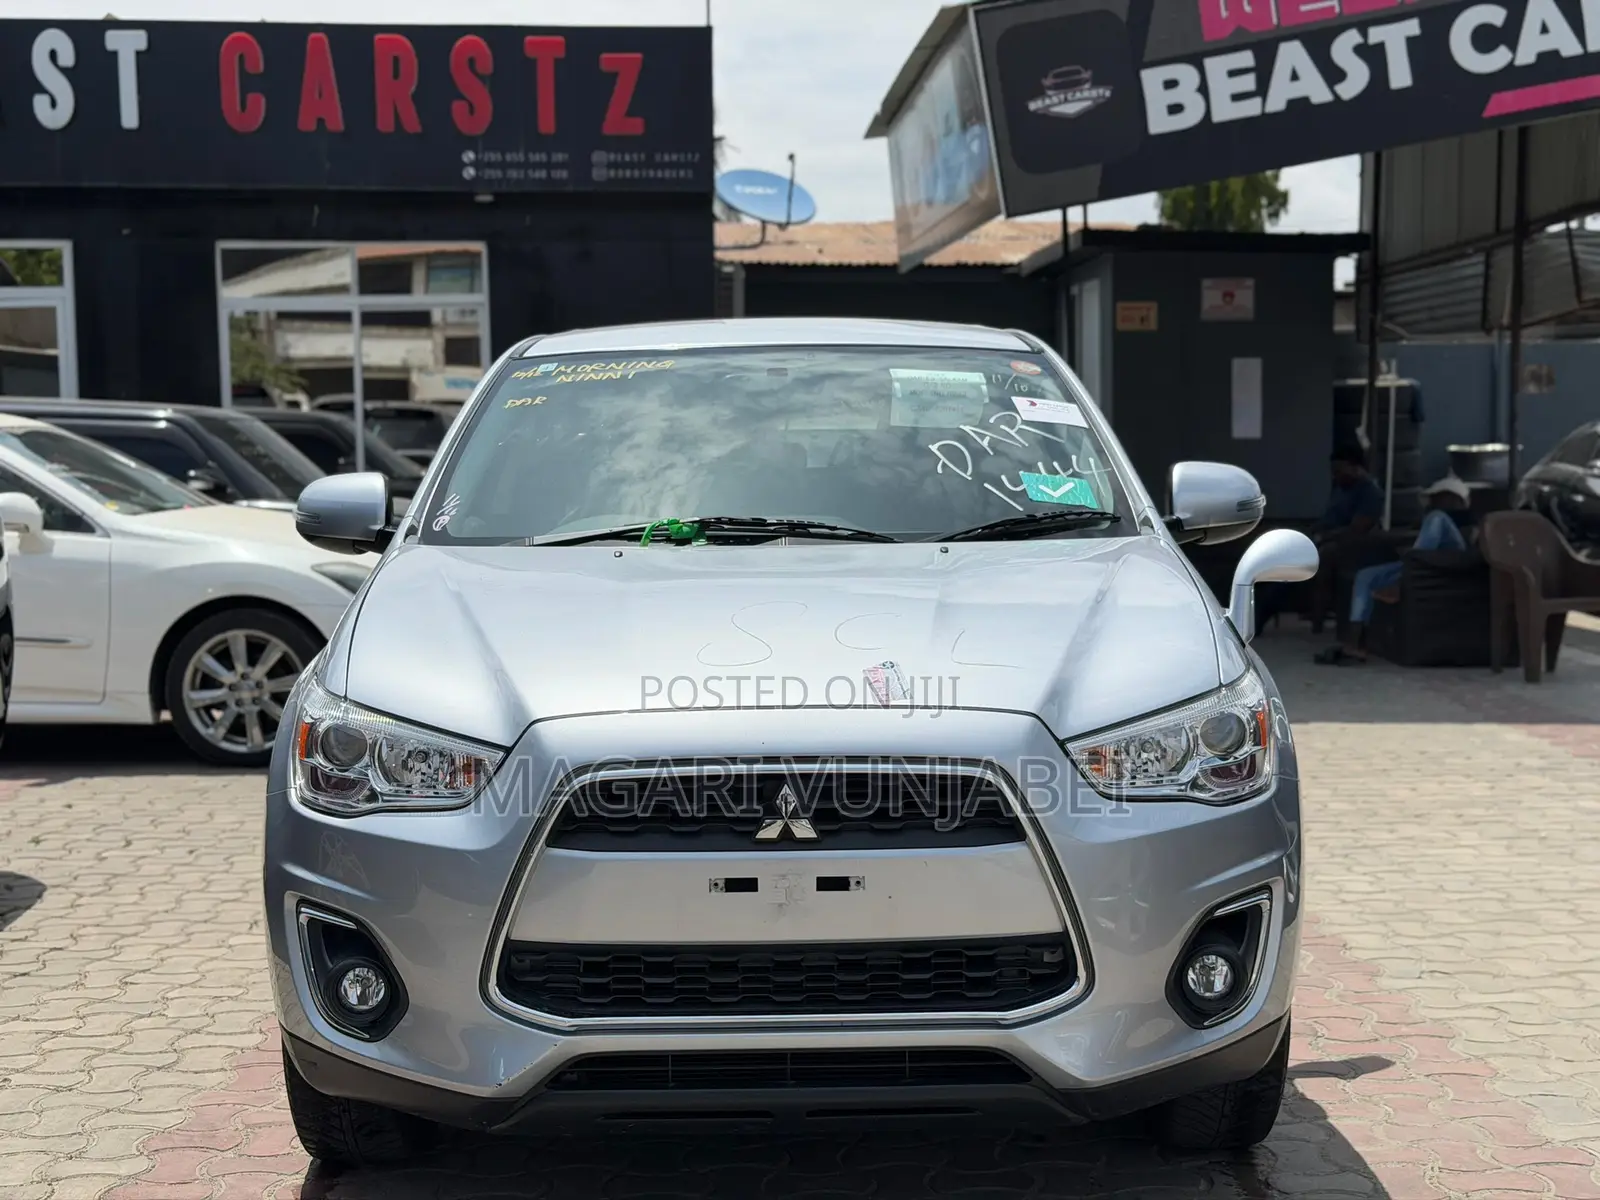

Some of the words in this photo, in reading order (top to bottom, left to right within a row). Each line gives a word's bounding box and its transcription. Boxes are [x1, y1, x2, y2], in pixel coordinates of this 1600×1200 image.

[219, 32, 645, 136] CARSTZ
[1139, 17, 1422, 135] BEAST
[928, 411, 1065, 480] DAR
